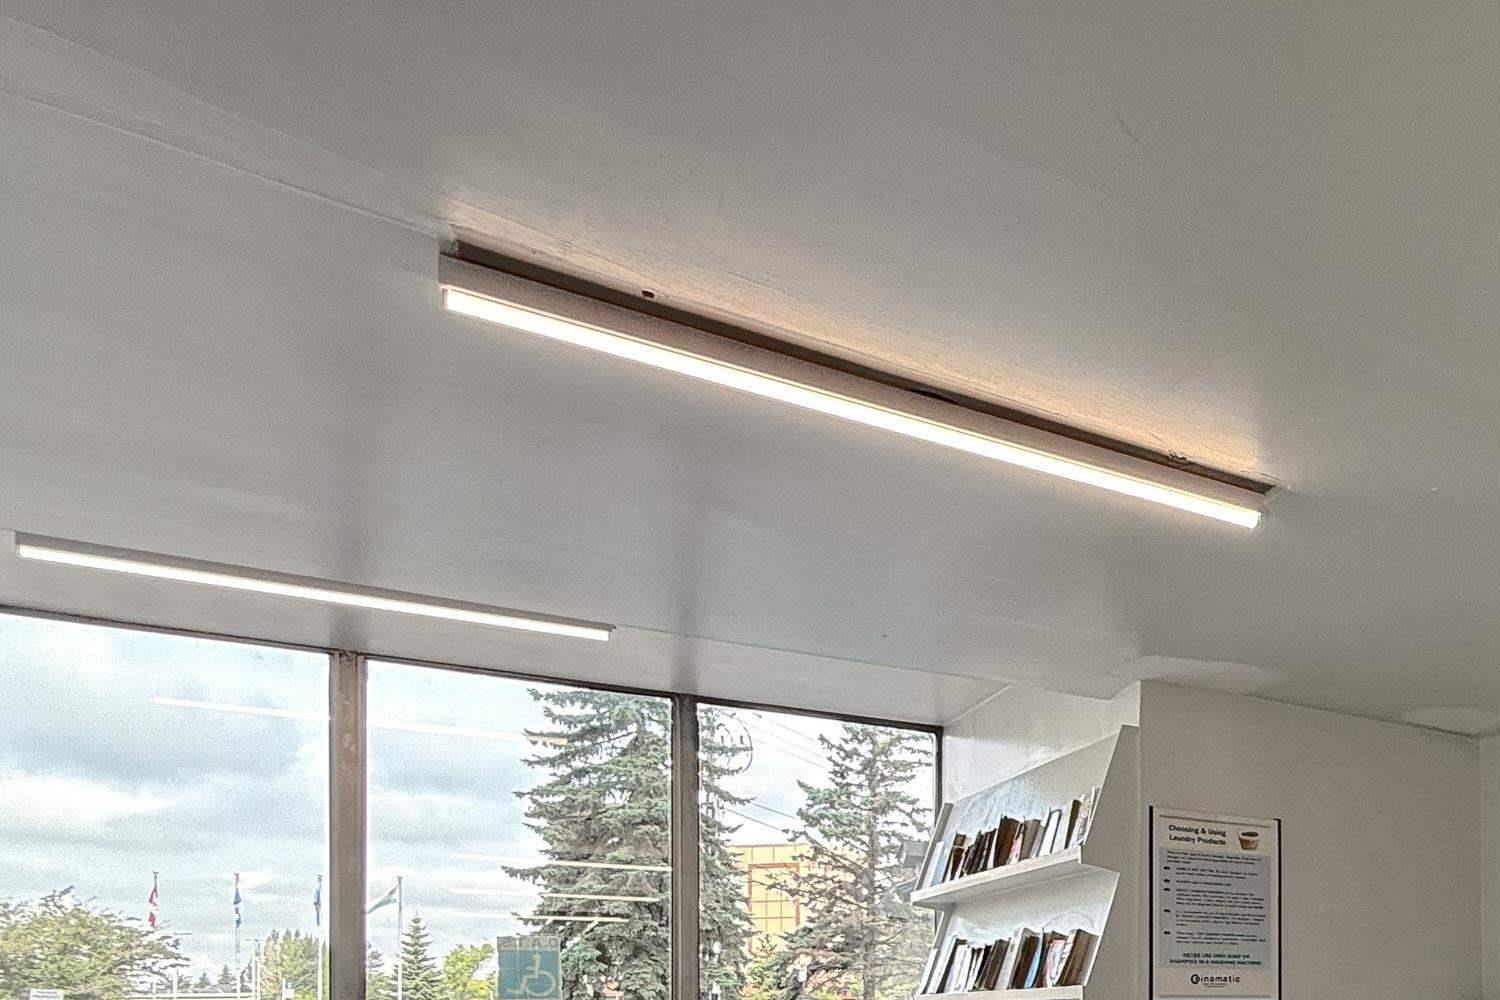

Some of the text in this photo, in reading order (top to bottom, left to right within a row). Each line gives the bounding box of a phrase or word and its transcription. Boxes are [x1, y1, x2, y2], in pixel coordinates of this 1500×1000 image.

[1168, 824, 1200, 835] Choosing
[1208, 828, 1226, 838] Using
[1169, 834, 1226, 846] Laundry Products
